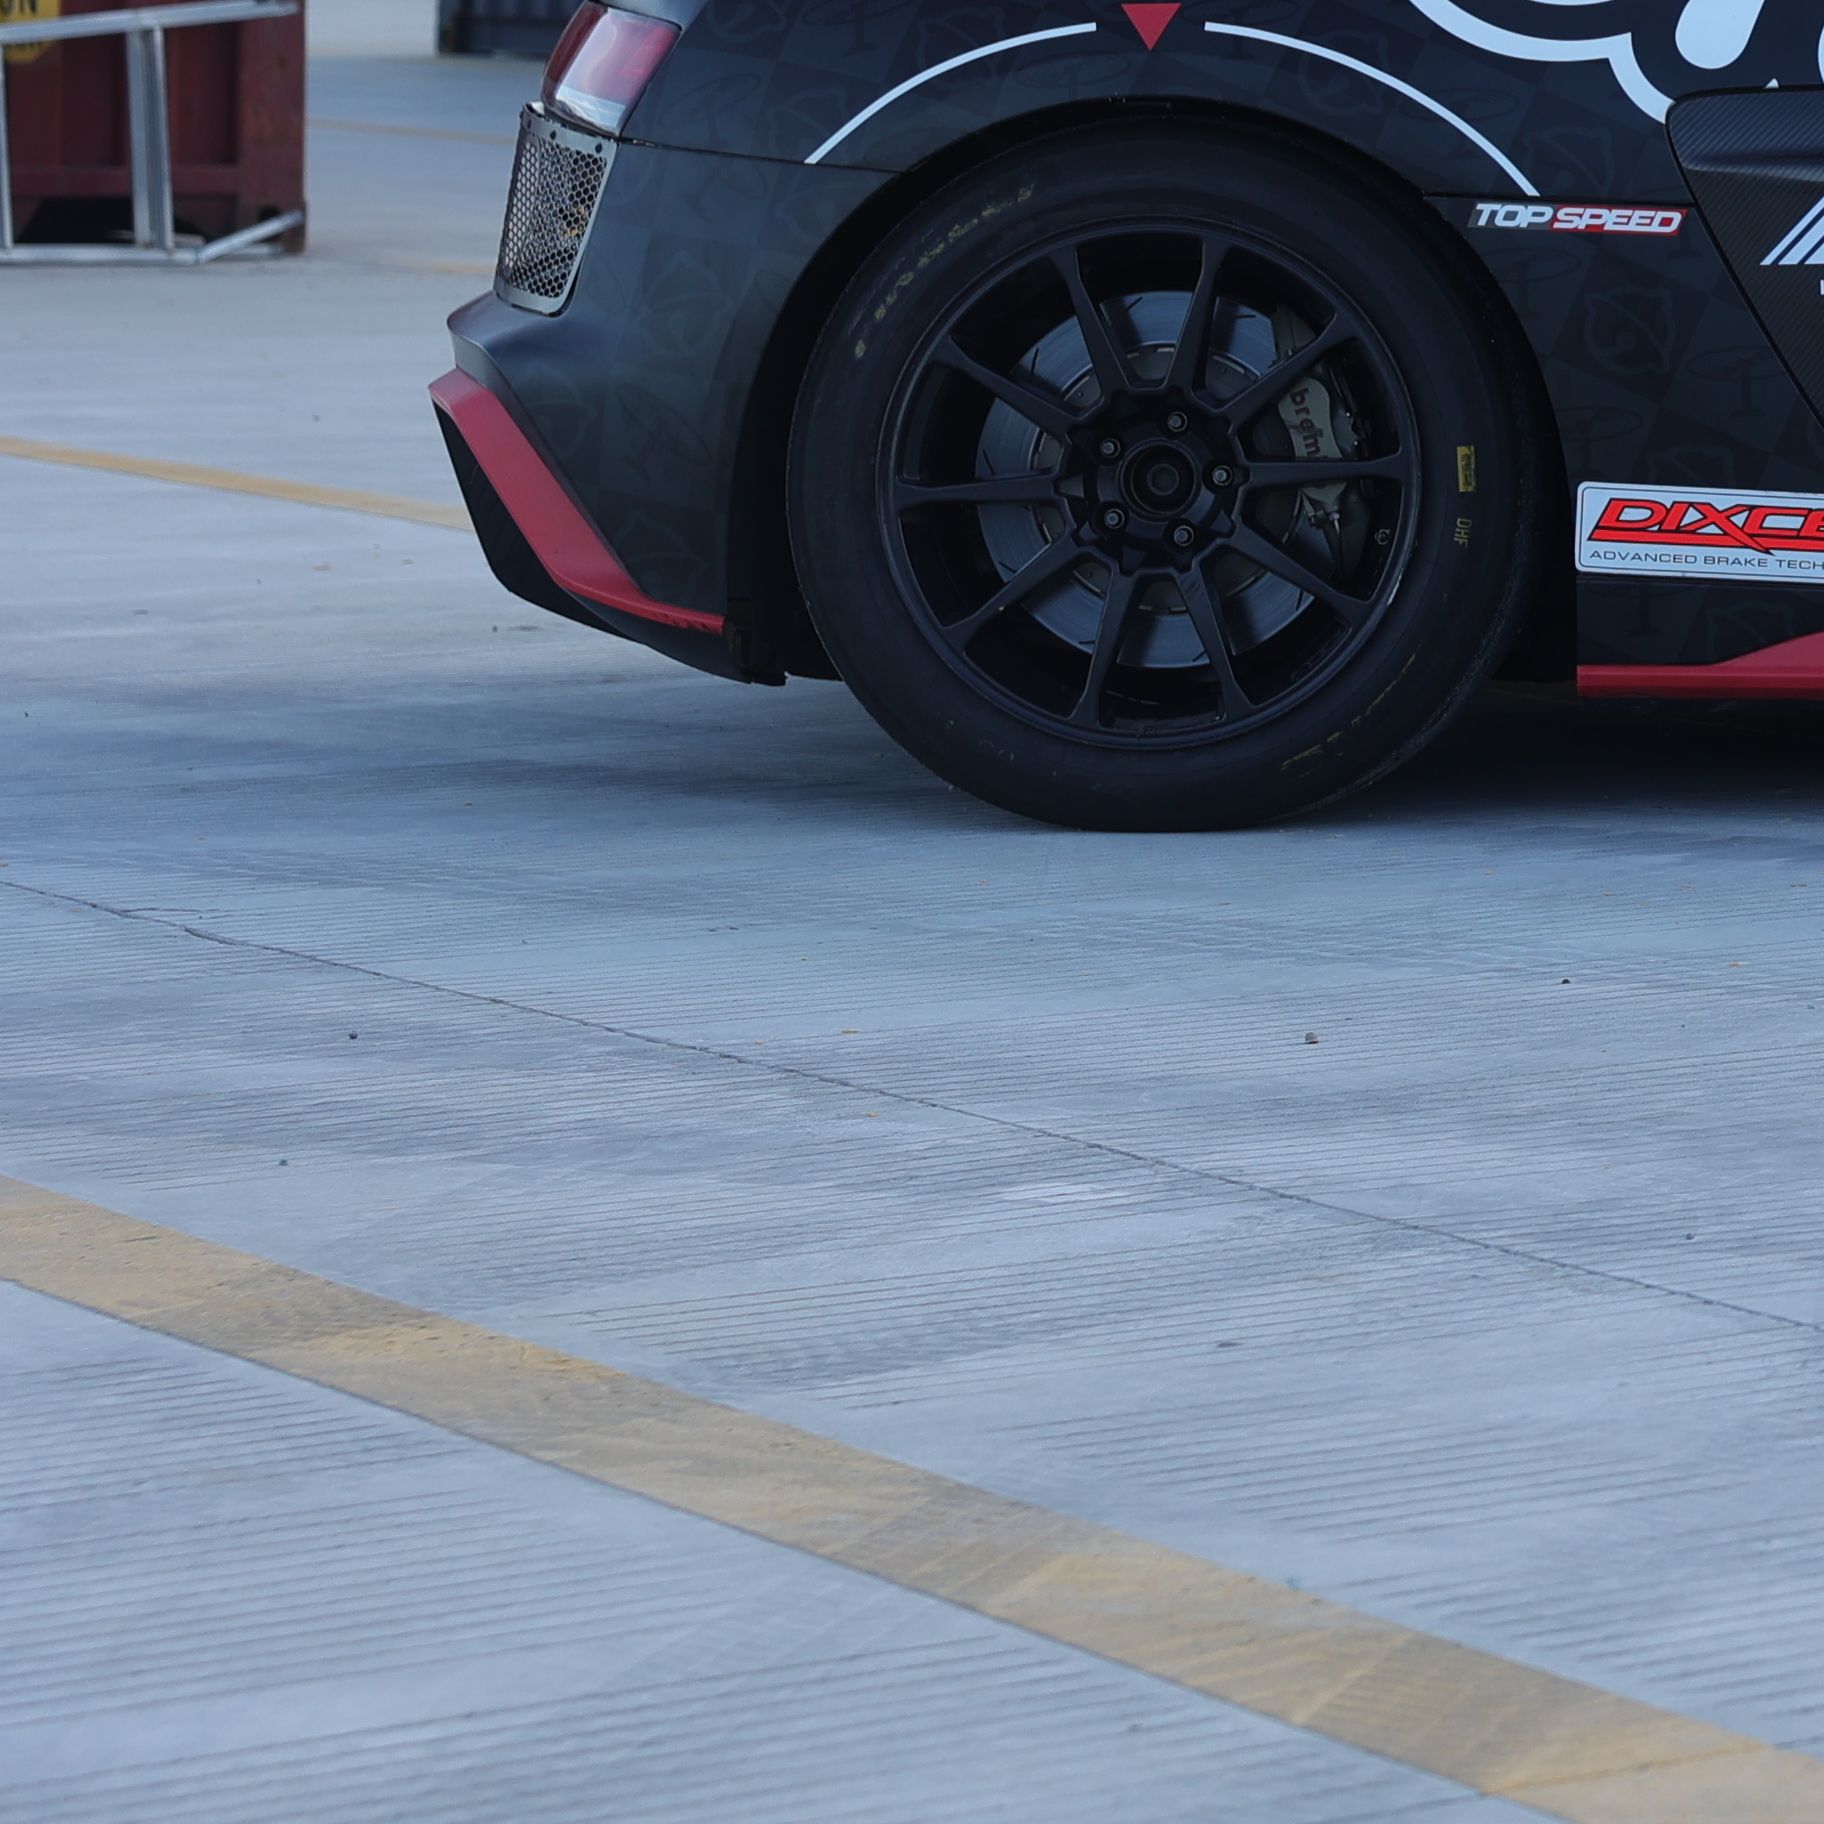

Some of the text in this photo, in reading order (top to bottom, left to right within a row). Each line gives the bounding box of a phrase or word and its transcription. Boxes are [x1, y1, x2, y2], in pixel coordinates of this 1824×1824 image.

[1452, 516, 1472, 547] DHF
[1589, 550, 1697, 564] ADVANCED
[1704, 555, 1769, 568] BRAKE
